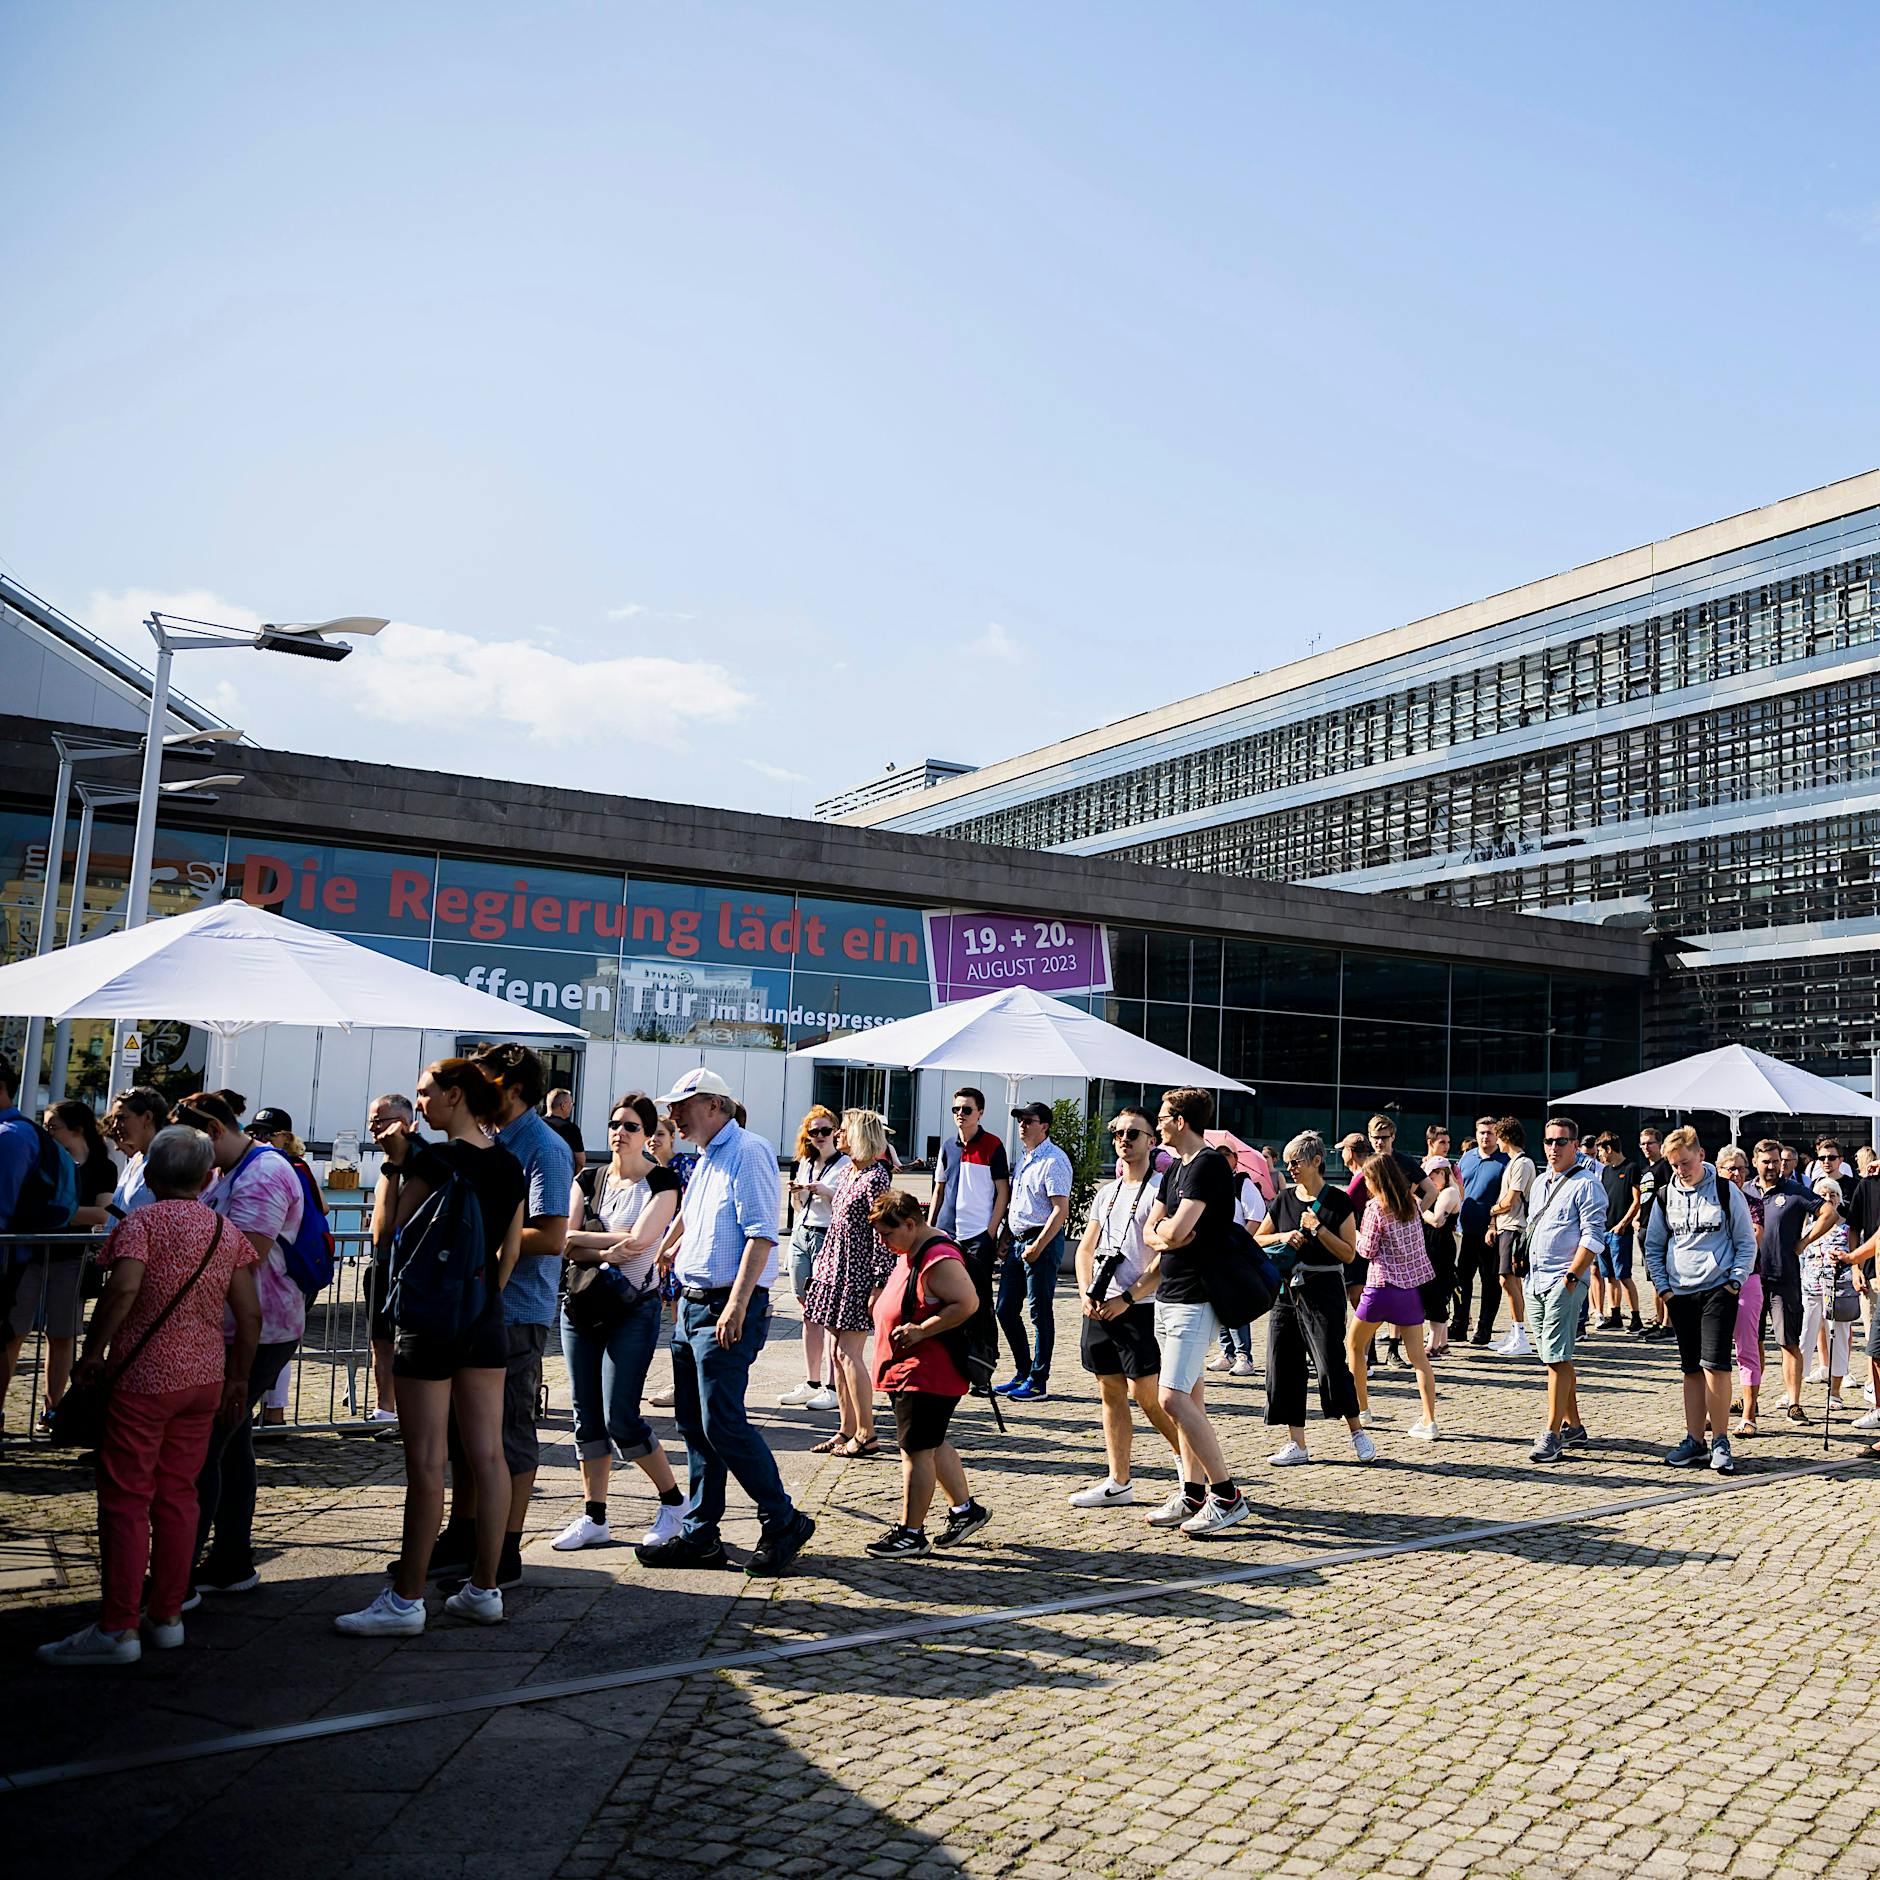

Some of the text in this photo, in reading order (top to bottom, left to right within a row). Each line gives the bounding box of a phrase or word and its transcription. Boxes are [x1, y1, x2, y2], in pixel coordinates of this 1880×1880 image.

[241, 854, 919, 965] Die Regierung lädt ein
[962, 921, 1075, 955] 19. + 20.
[966, 954, 1077, 981] AUGUST 2023
[625, 978, 698, 1017] Tür
[709, 998, 738, 1020] im
